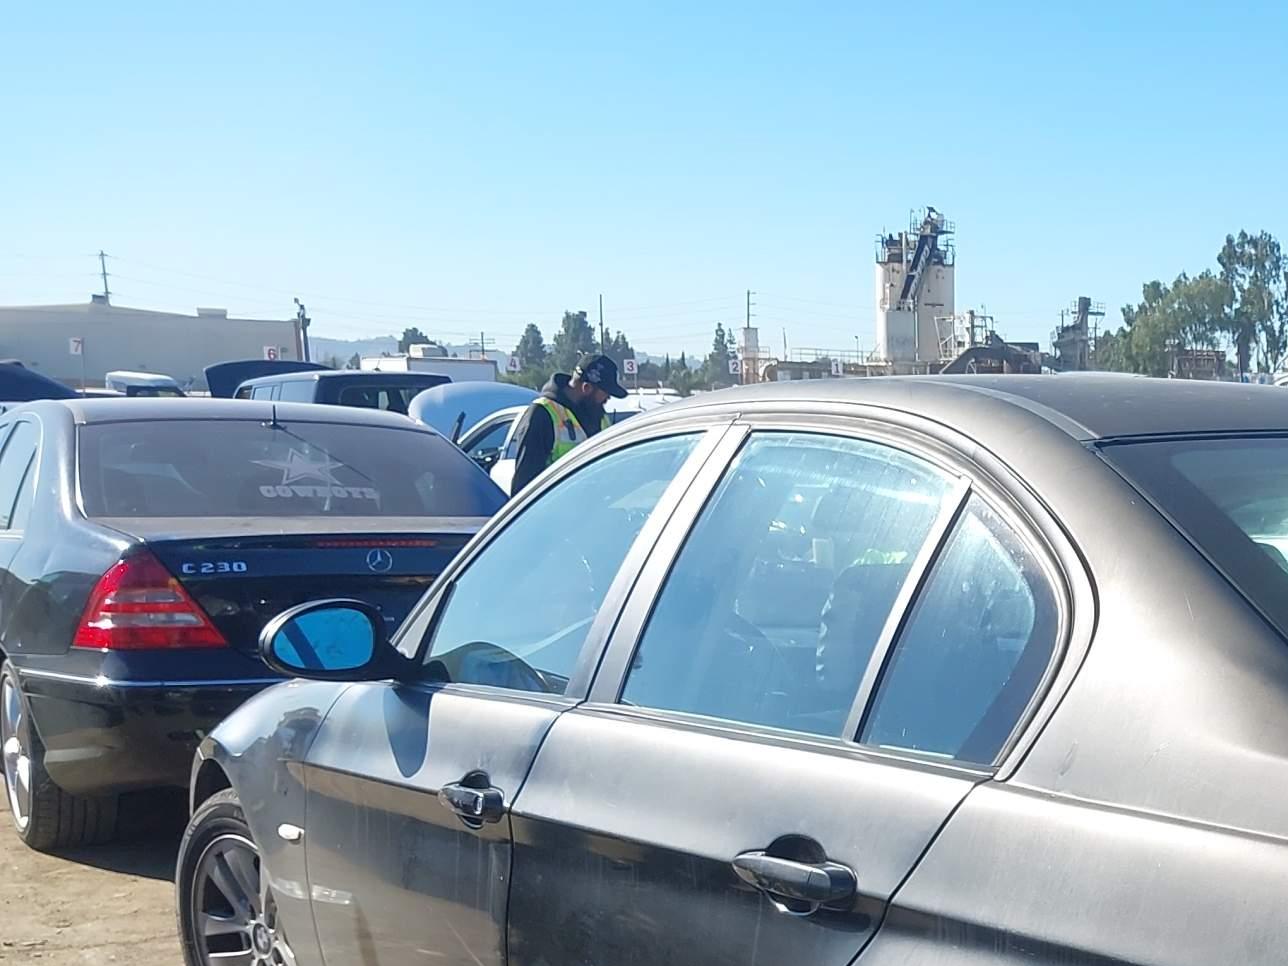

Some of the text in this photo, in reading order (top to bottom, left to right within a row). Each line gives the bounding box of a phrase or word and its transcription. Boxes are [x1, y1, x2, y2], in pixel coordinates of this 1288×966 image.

[71, 339, 81, 353] 7
[267, 348, 277, 361] 6
[626, 360, 635, 372] 3
[182, 561, 248, 574] C 230
